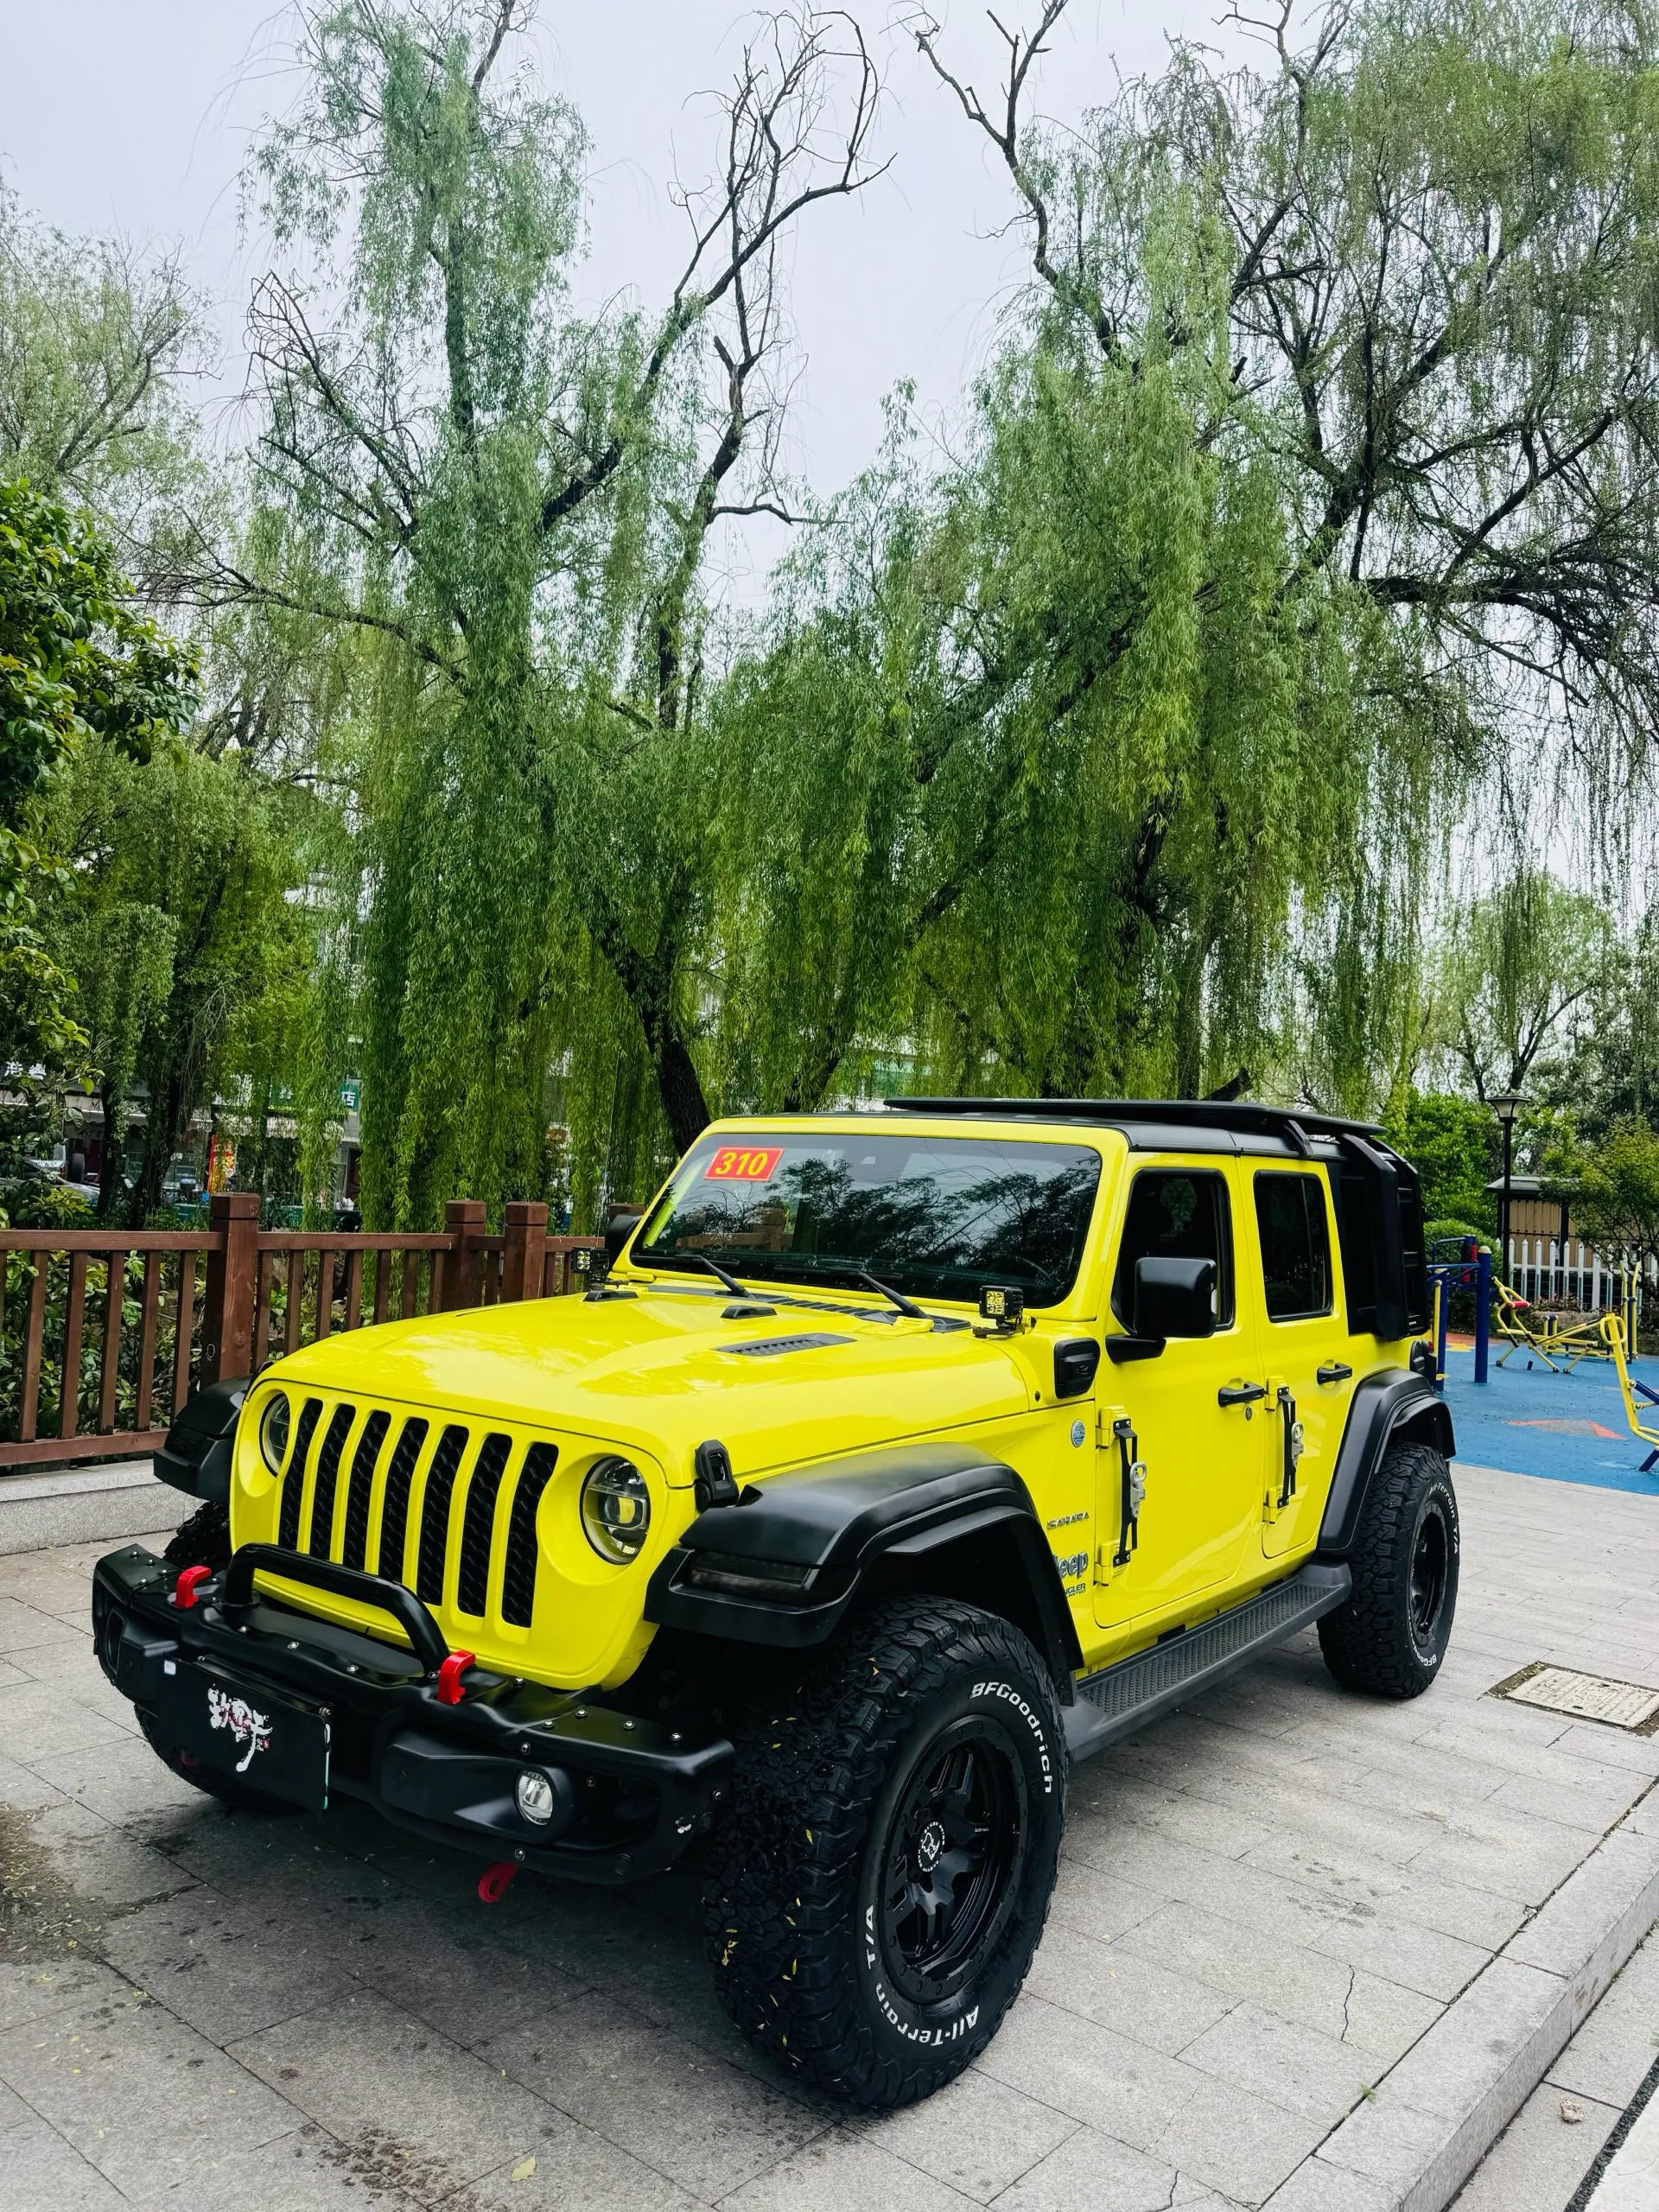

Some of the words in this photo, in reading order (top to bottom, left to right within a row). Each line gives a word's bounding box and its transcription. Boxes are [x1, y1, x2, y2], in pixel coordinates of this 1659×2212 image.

[715, 1152, 768, 1176] 310
[969, 1681, 1052, 1793] BFGoodrich
[865, 1904, 876, 1970] T/A
[875, 1982, 979, 2047] All-Terrain
